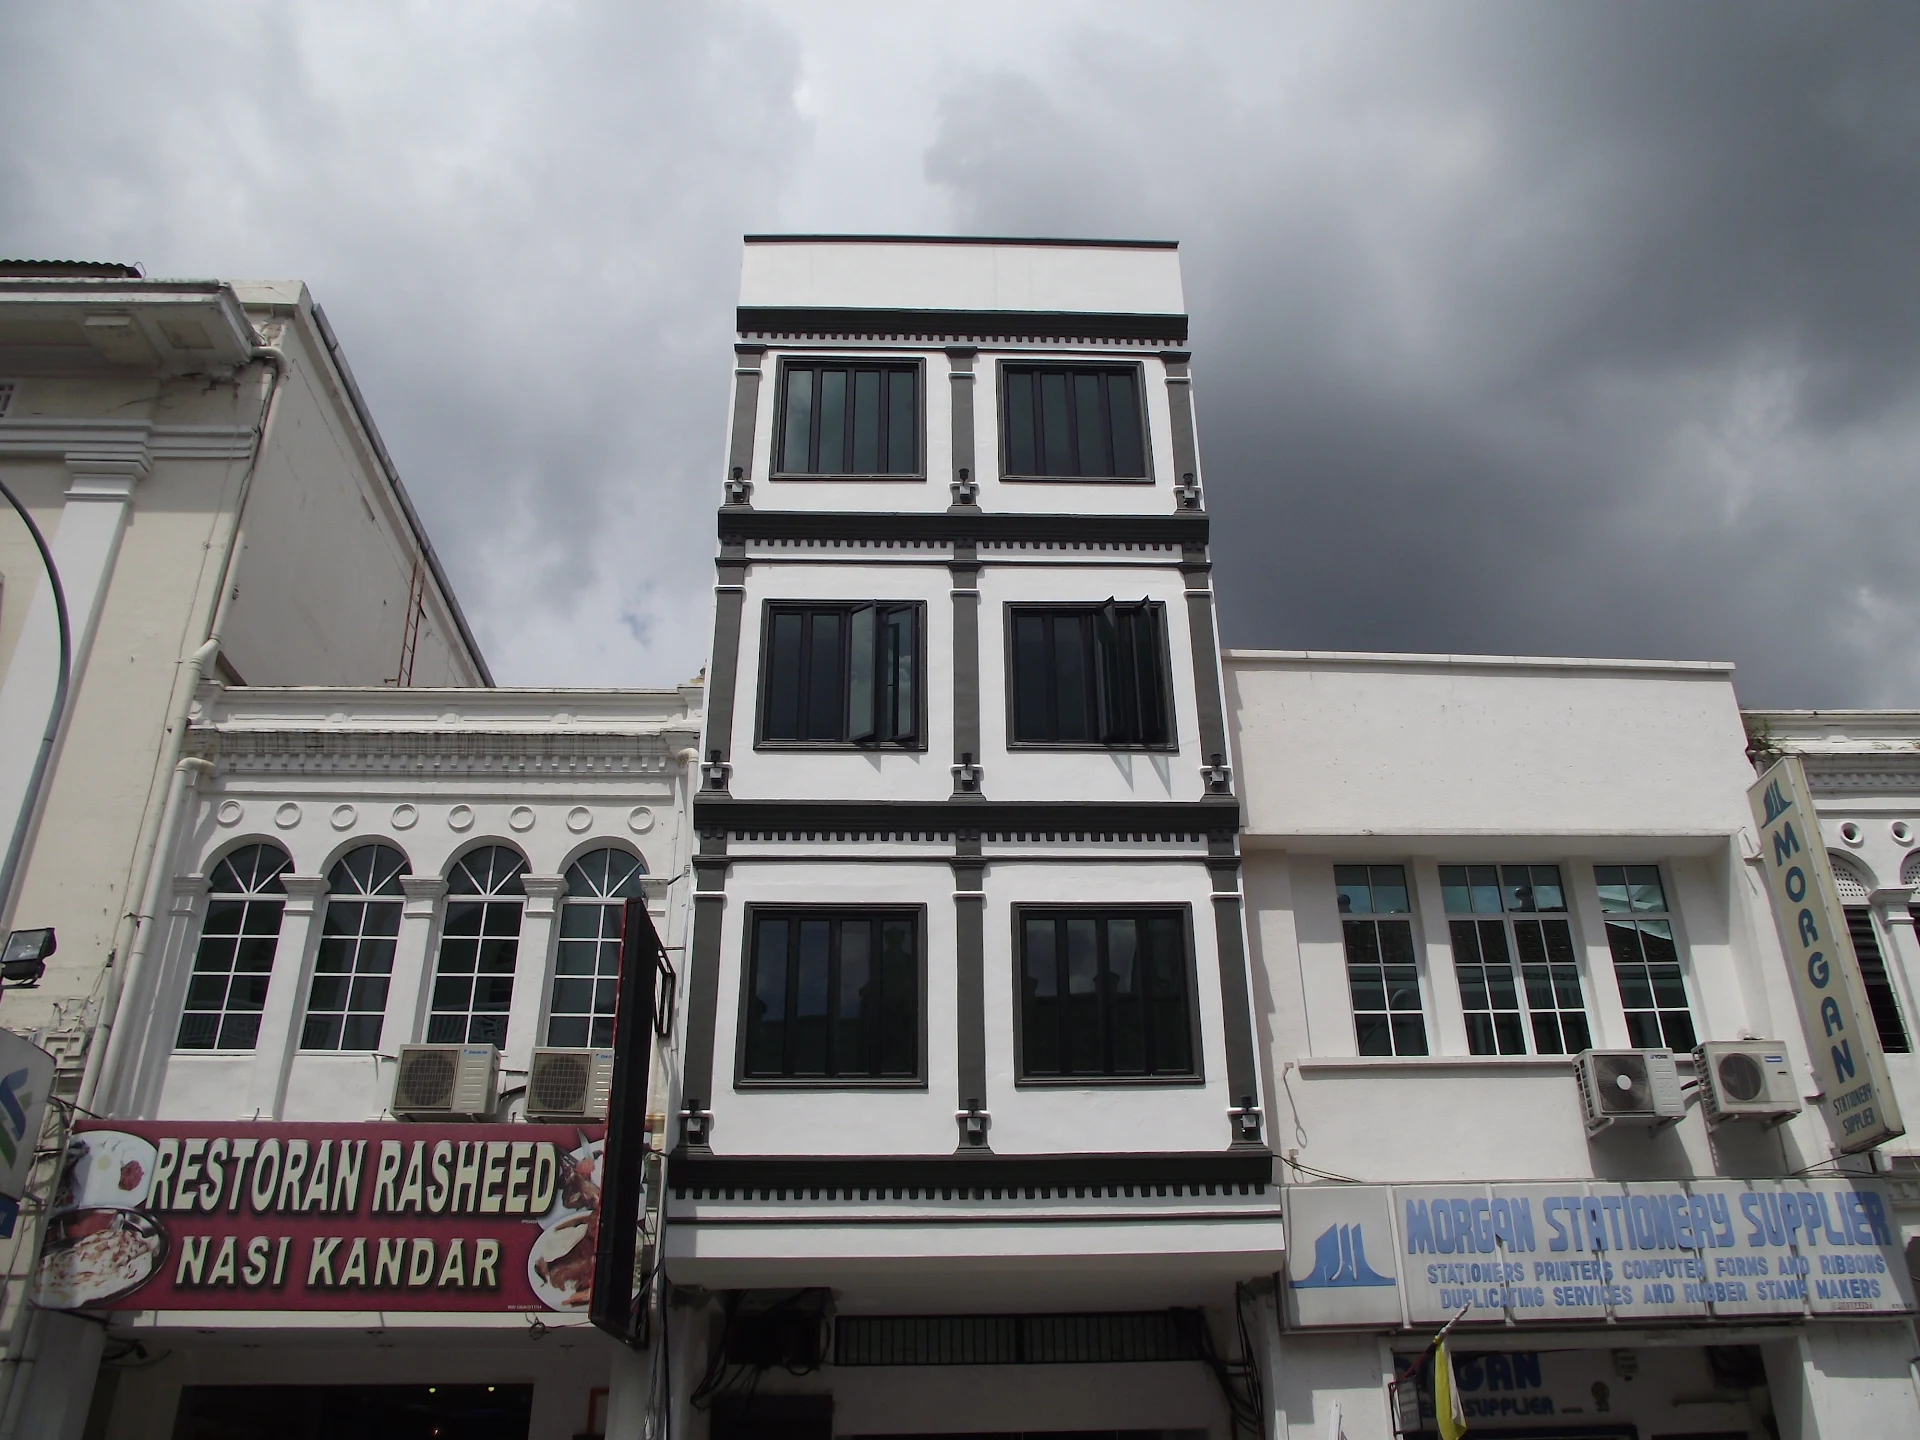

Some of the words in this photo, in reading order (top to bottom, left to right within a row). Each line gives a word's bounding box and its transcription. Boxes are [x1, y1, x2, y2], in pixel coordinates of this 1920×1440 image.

[1773, 821, 1856, 1084] MORGAN
[1833, 1083, 1873, 1115] STATIONERY
[1843, 1107, 1876, 1136] SUPPLIER
[145, 1138, 368, 1213] RESTORAN
[371, 1140, 558, 1214] RASHEED
[1406, 1197, 1536, 1254] MORGAN
[1543, 1193, 1735, 1252] STATIONERY
[1739, 1191, 1893, 1248] SUPPLIER
[175, 1236, 292, 1286] NASI
[307, 1237, 501, 1287] KANDAR
[1427, 1261, 1525, 1284] STATIONERS
[1534, 1260, 1614, 1282] PRINTERS
[1622, 1258, 1706, 1281] COMPUTER
[1715, 1256, 1769, 1278] FORMS
[1779, 1255, 1810, 1276] AND
[1819, 1253, 1886, 1275] RIBBONS
[1440, 1286, 1545, 1309] DUPLICATING
[1553, 1285, 1633, 1306] SERVICES
[1643, 1282, 1675, 1304] AND
[1683, 1281, 1748, 1302] RUBBER
[1756, 1279, 1808, 1300] STAMP
[1815, 1278, 1882, 1300] MAKERS
[1466, 1396, 1555, 1417] SUPPLIER
